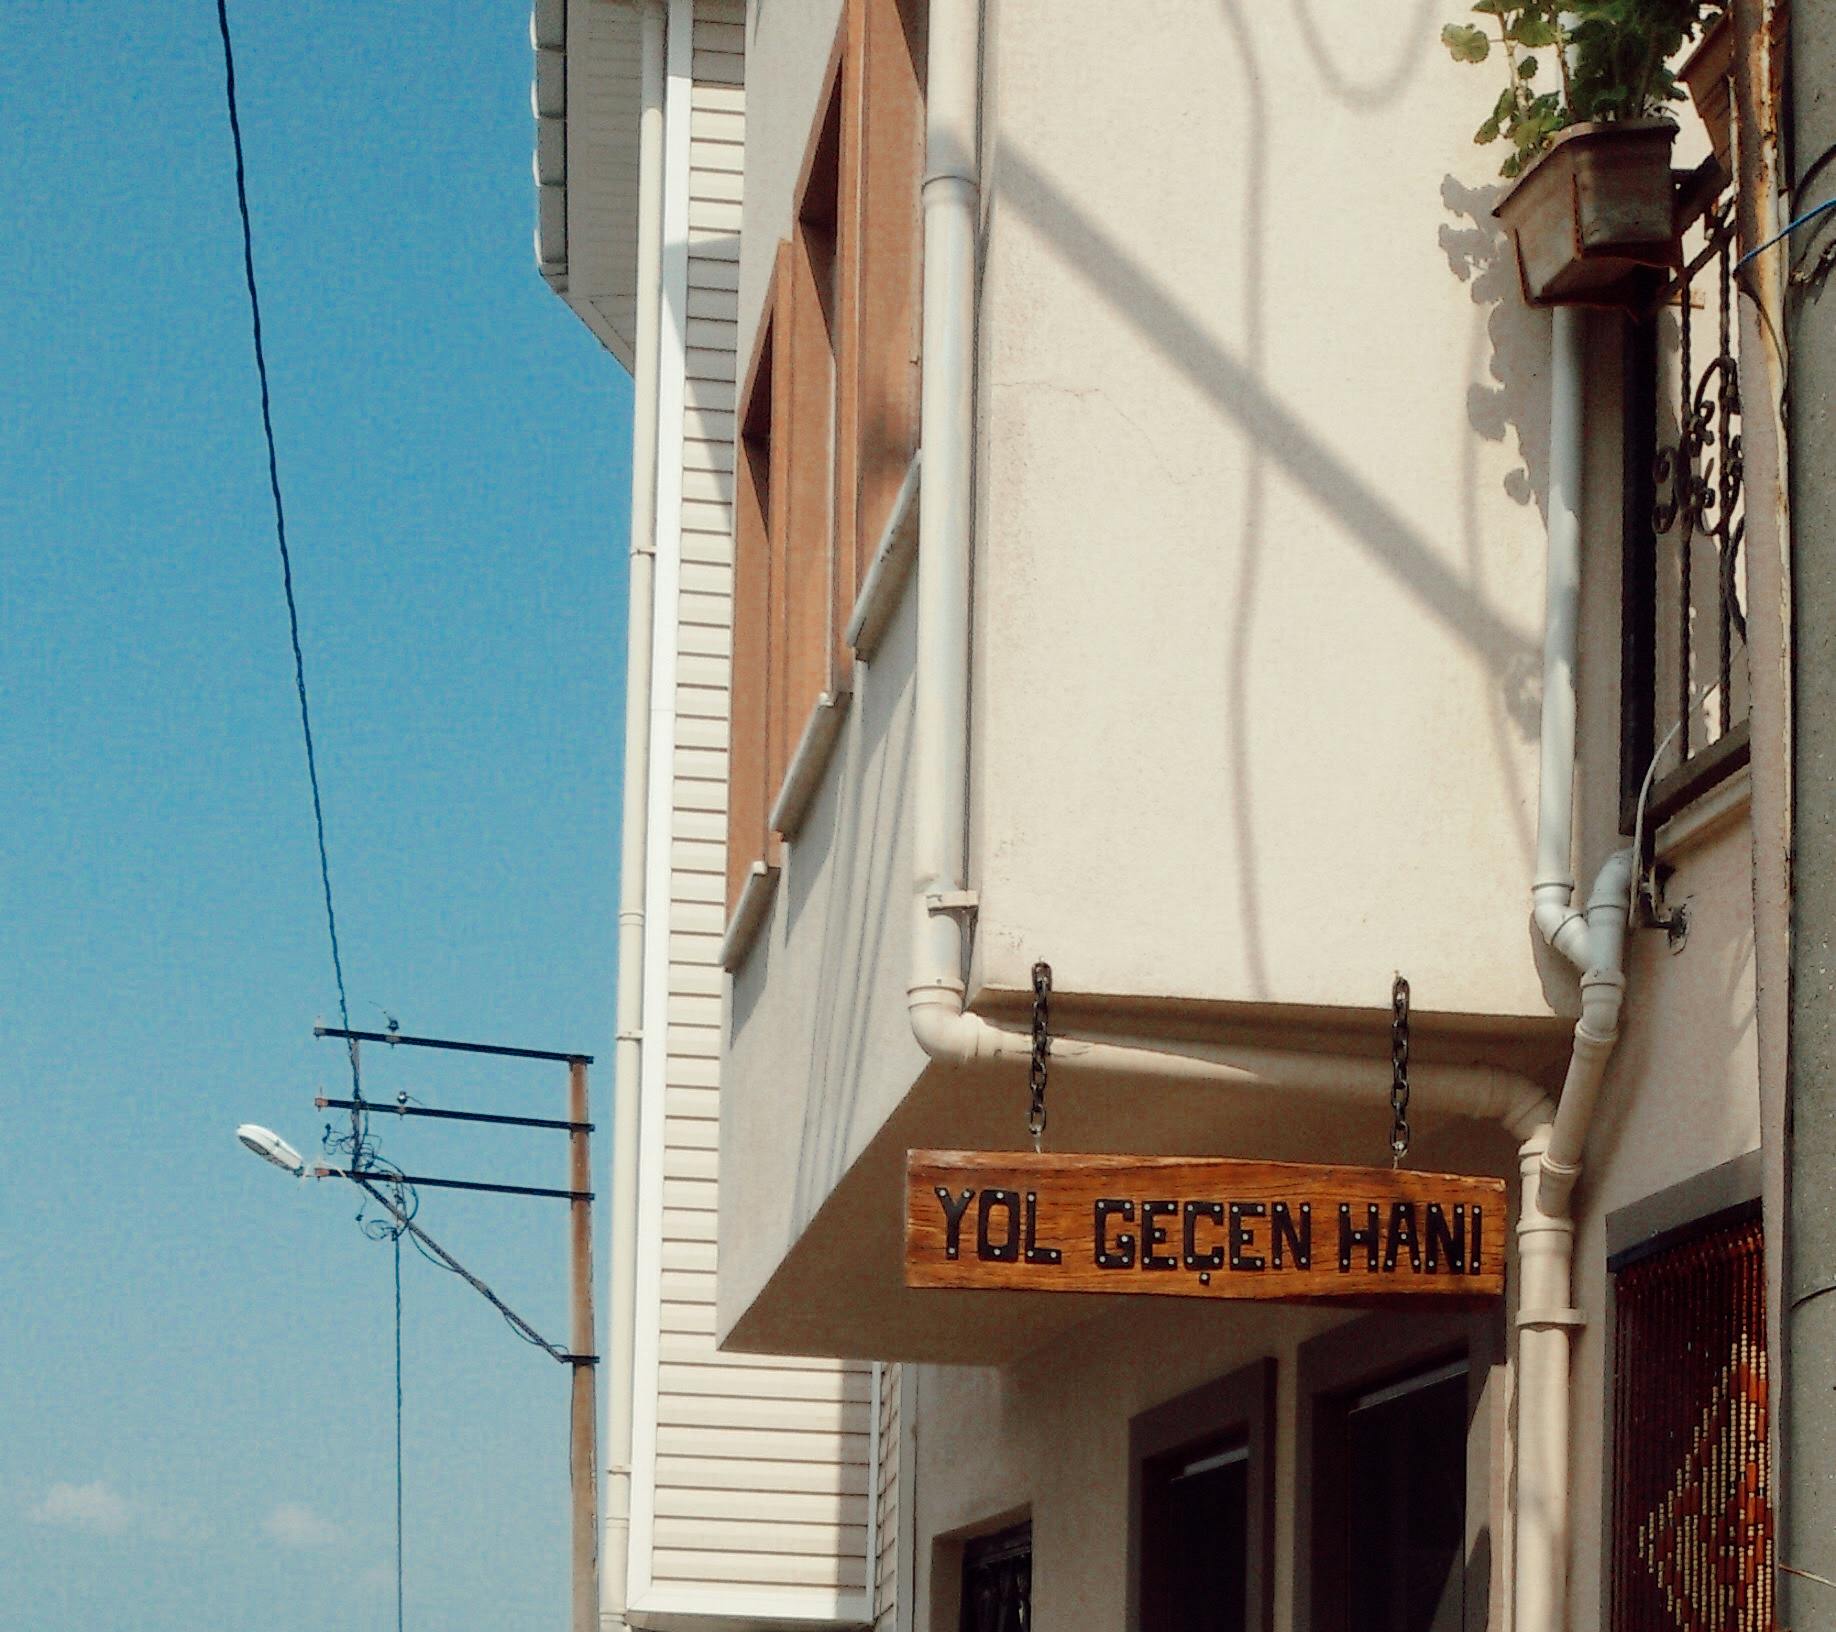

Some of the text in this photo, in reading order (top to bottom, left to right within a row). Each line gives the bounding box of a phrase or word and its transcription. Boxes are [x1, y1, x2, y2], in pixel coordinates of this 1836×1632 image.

[934, 1187, 1482, 1286] YOL GEÇEN HANI
